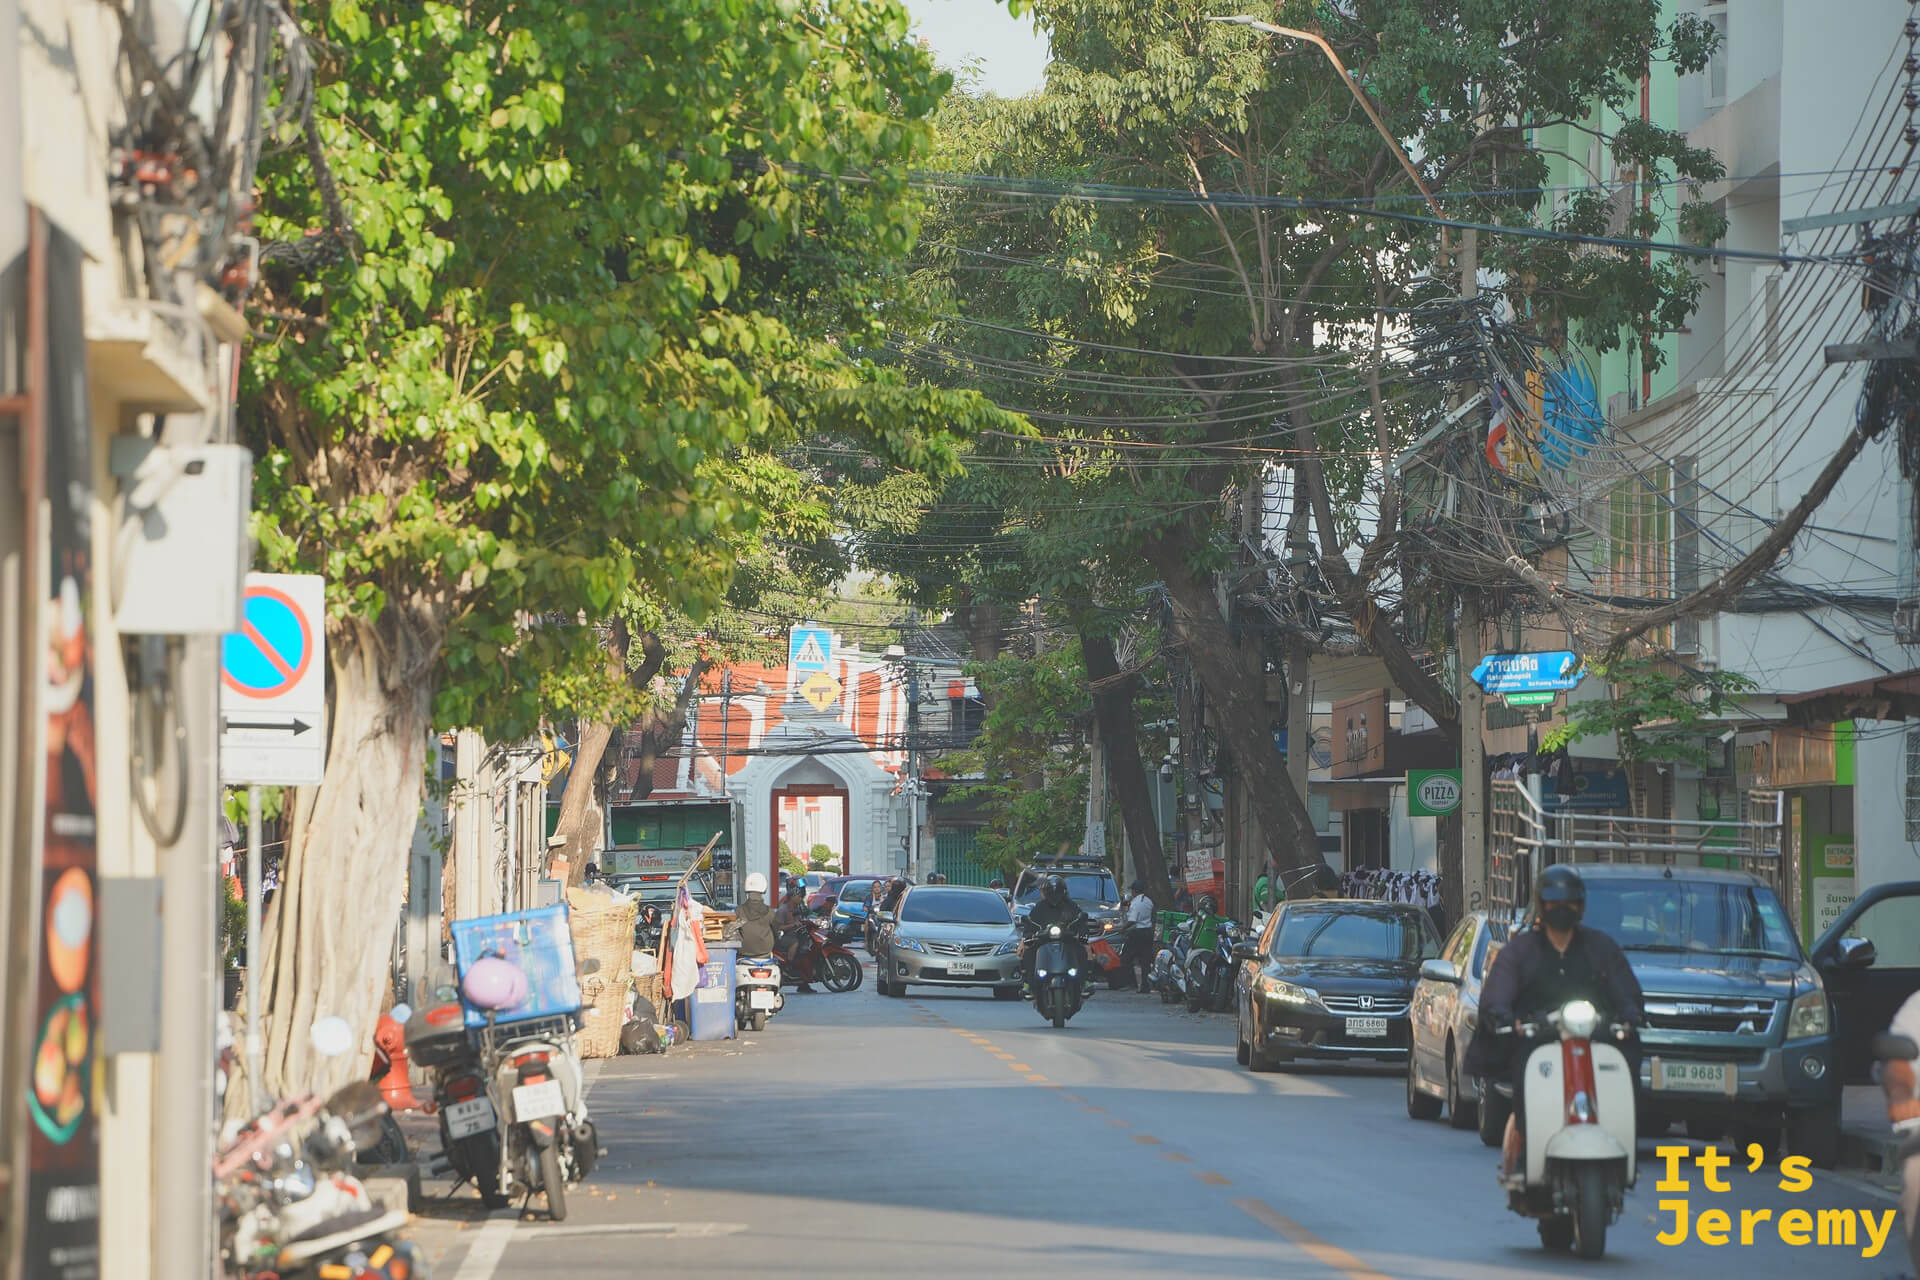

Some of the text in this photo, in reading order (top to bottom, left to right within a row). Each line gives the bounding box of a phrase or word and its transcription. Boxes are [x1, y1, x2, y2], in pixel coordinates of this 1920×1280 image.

[1424, 786, 1455, 800] PIZZA
[1826, 894, 1856, 903] รับเฉพ
[1691, 1065, 1723, 1080] 9683
